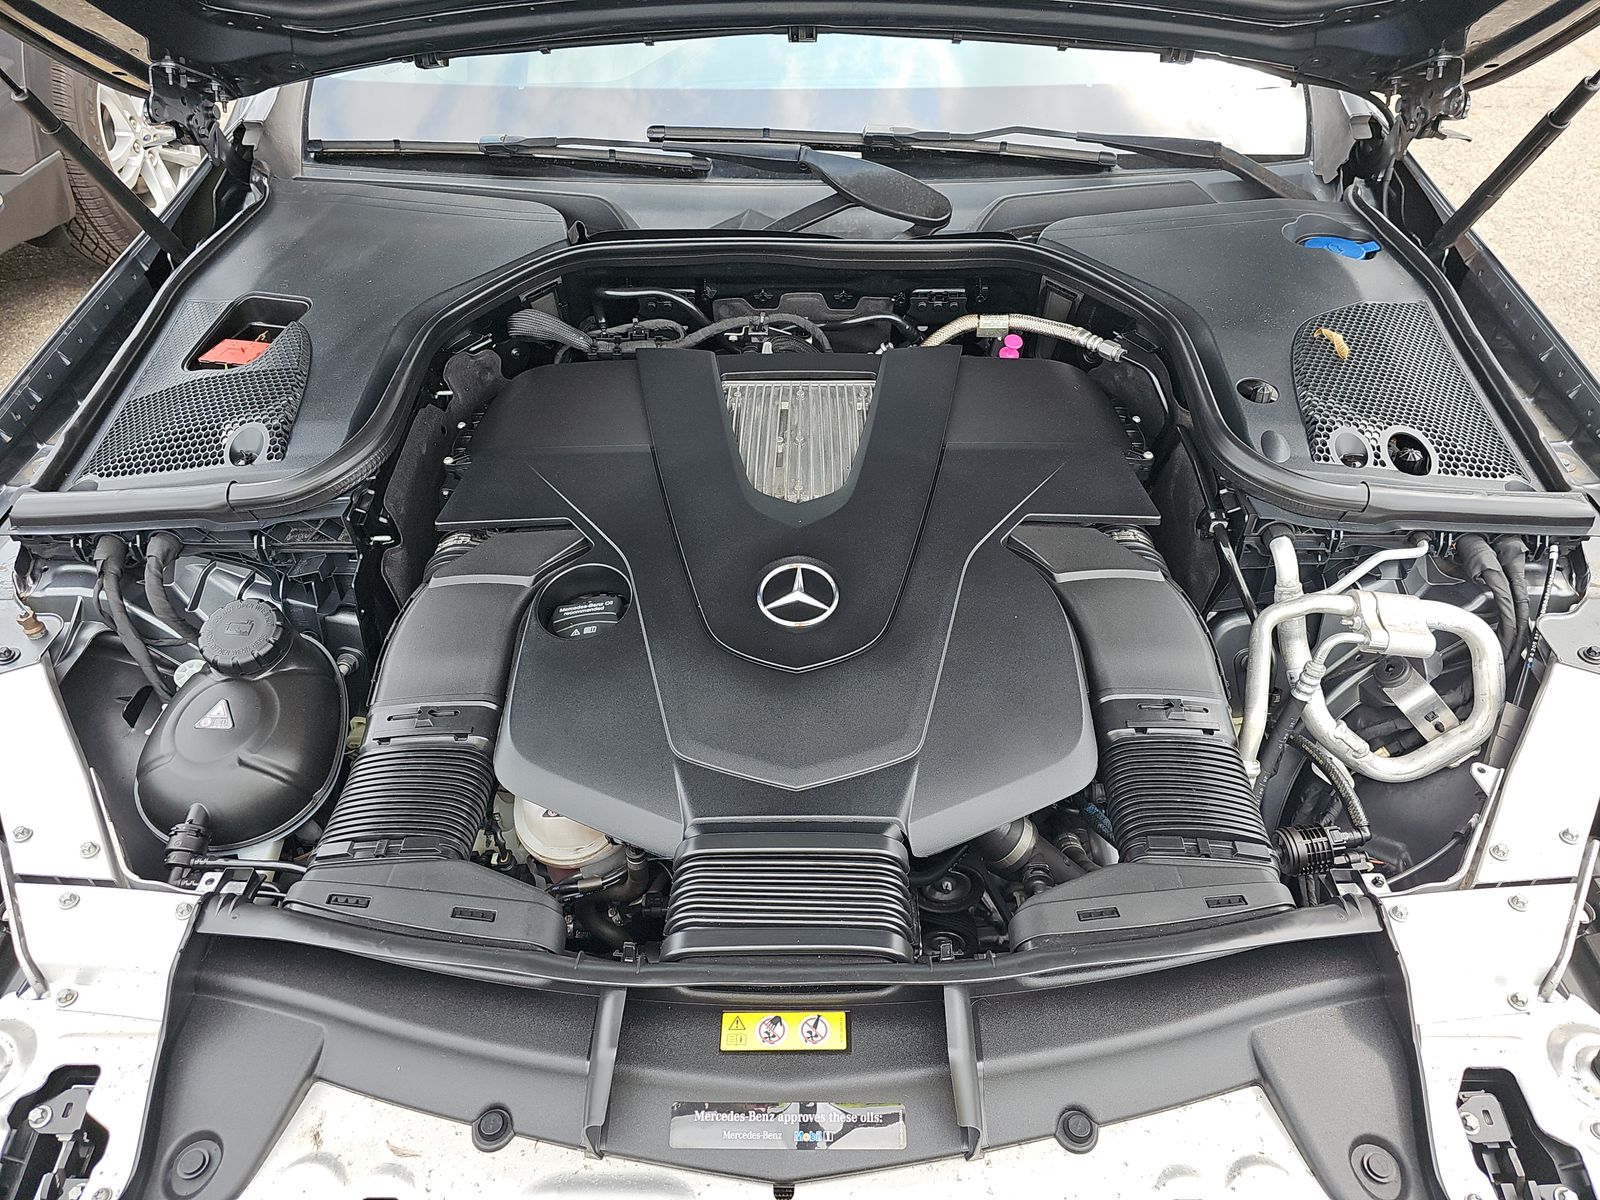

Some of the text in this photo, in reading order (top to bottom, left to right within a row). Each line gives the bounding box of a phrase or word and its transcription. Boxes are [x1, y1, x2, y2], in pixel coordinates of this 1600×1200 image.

[559, 602, 604, 613] Mercedes-Benz
[563, 606, 605, 616] recommended
[694, 1110, 884, 1125] Mercedes-Benz approves these oils:
[722, 1130, 783, 1141] Mercedes-Benz
[793, 1130, 823, 1142] Mobil
